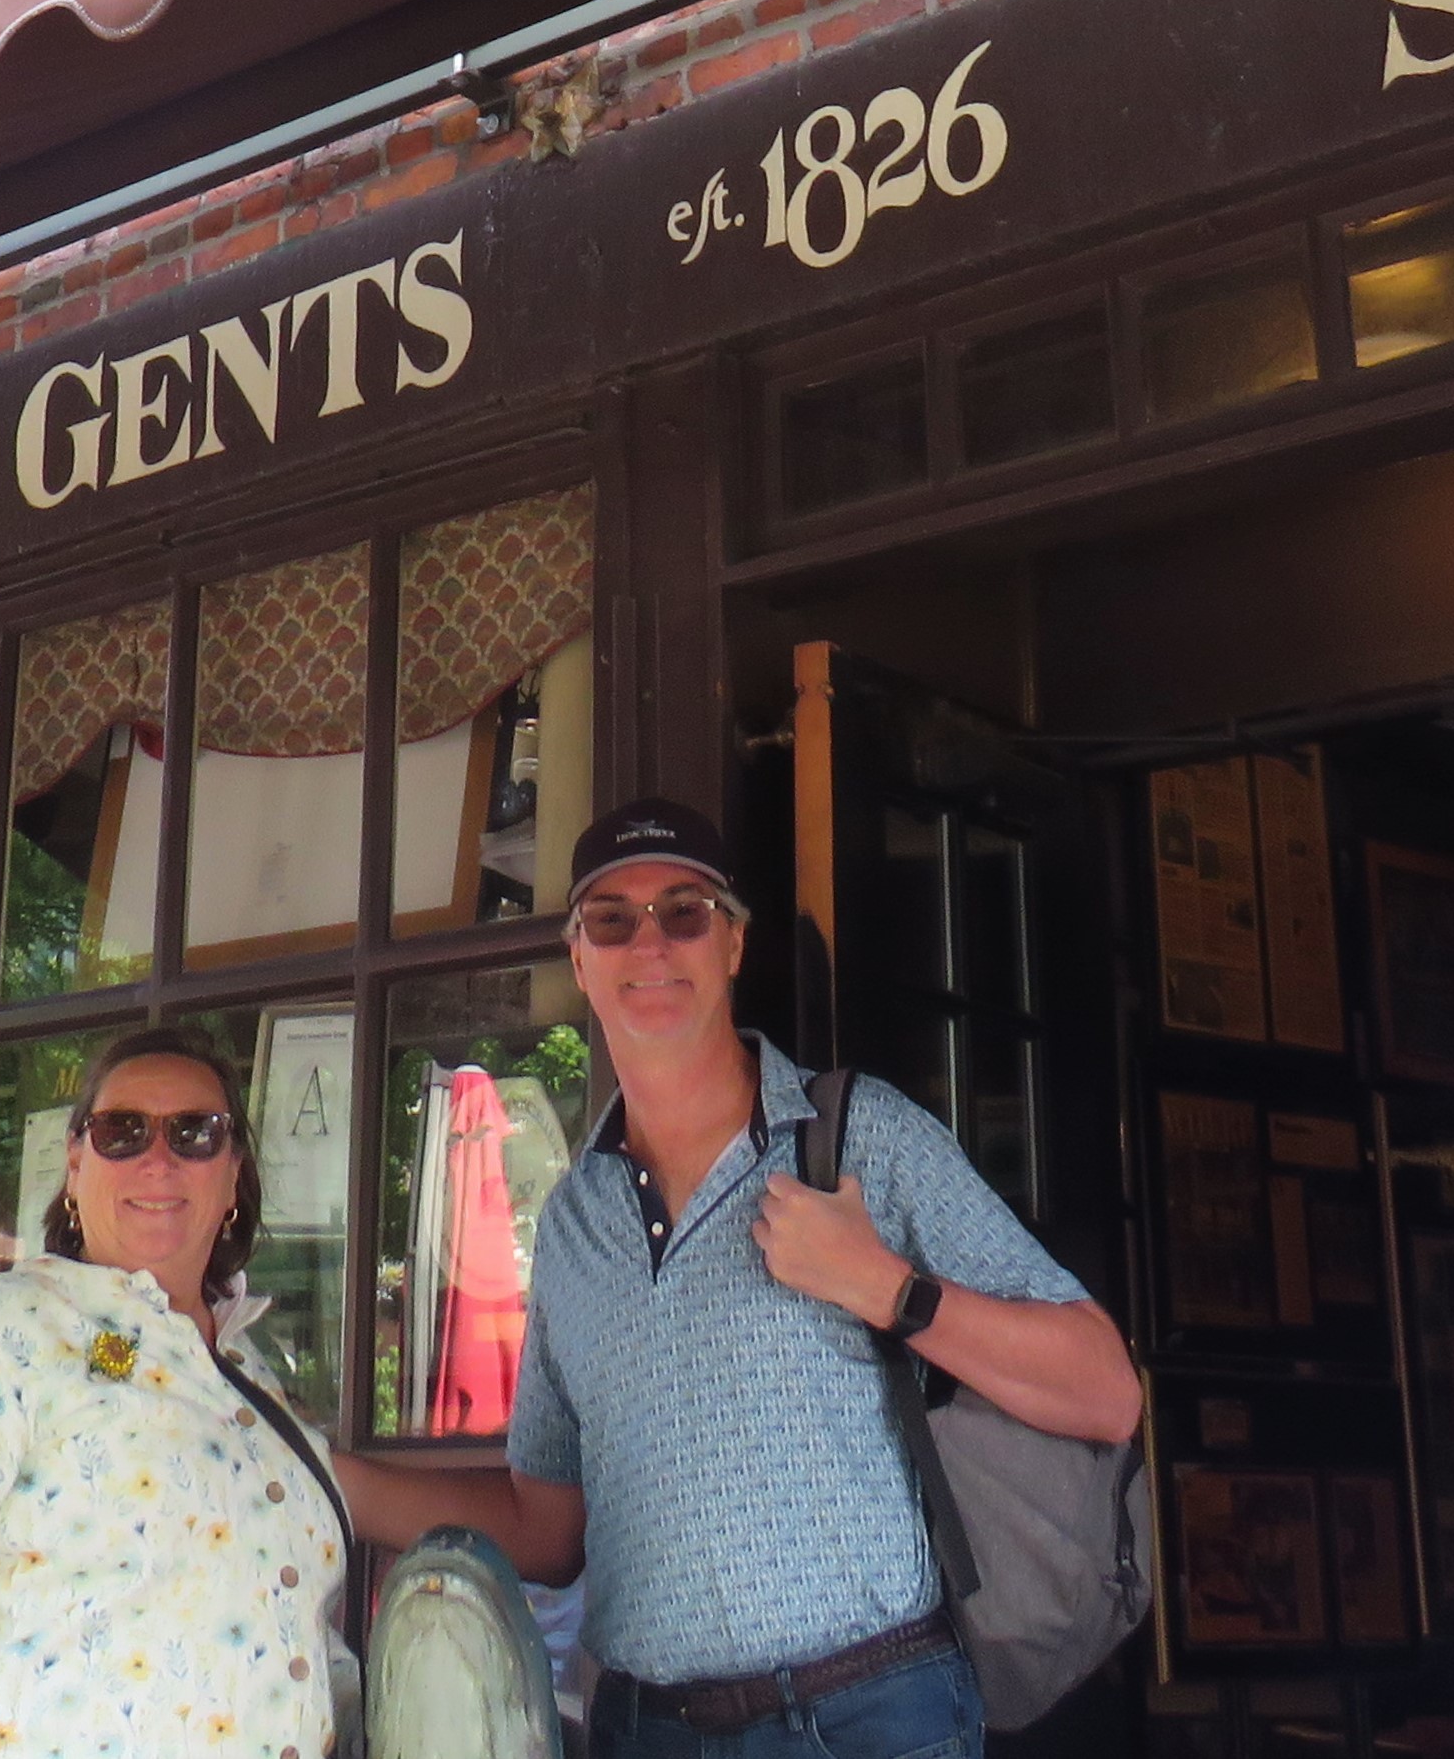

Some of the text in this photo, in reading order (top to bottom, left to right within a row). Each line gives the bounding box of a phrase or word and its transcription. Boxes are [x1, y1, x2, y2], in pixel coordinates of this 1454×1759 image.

[759, 39, 1008, 269] 1826
[15, 229, 474, 511] GENTS
[285, 1064, 331, 1137] A
